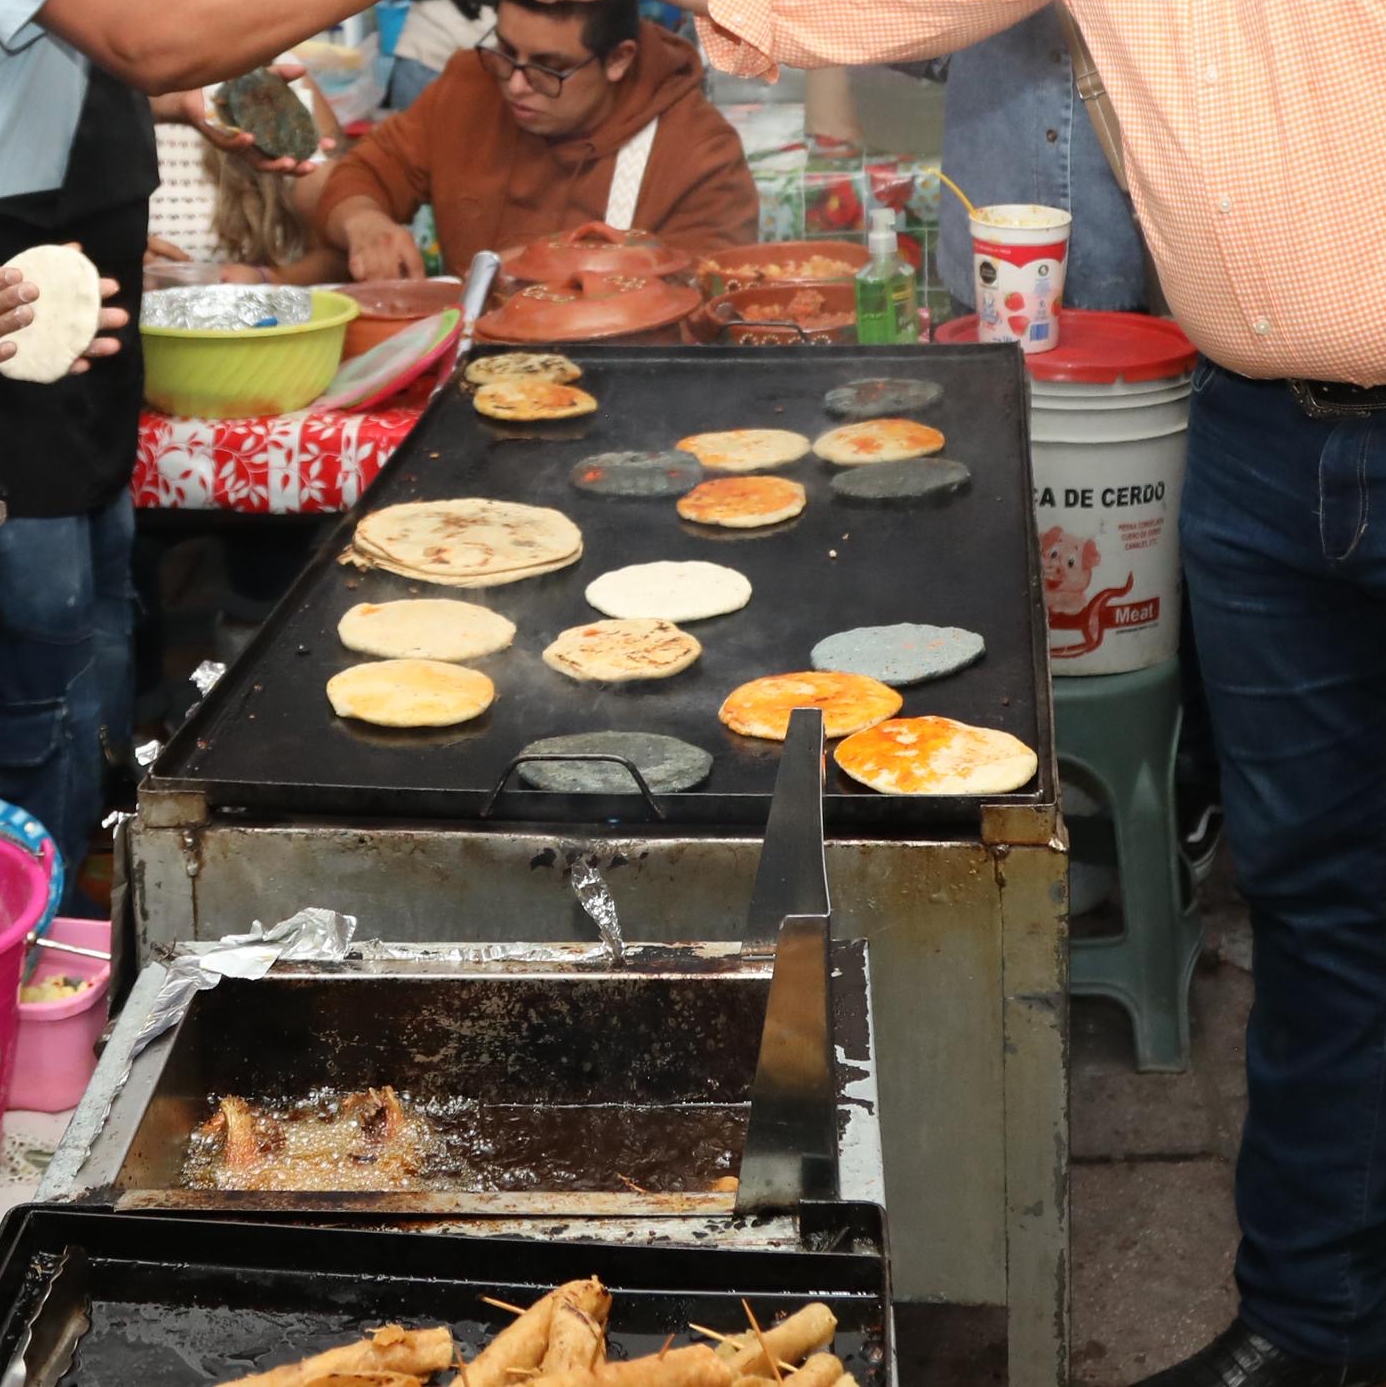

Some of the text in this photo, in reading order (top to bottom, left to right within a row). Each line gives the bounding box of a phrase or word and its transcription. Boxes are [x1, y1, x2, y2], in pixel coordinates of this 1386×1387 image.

[1064, 489, 1094, 509] DE
[1101, 481, 1166, 508] CERDO
[1115, 602, 1154, 625] Meat
